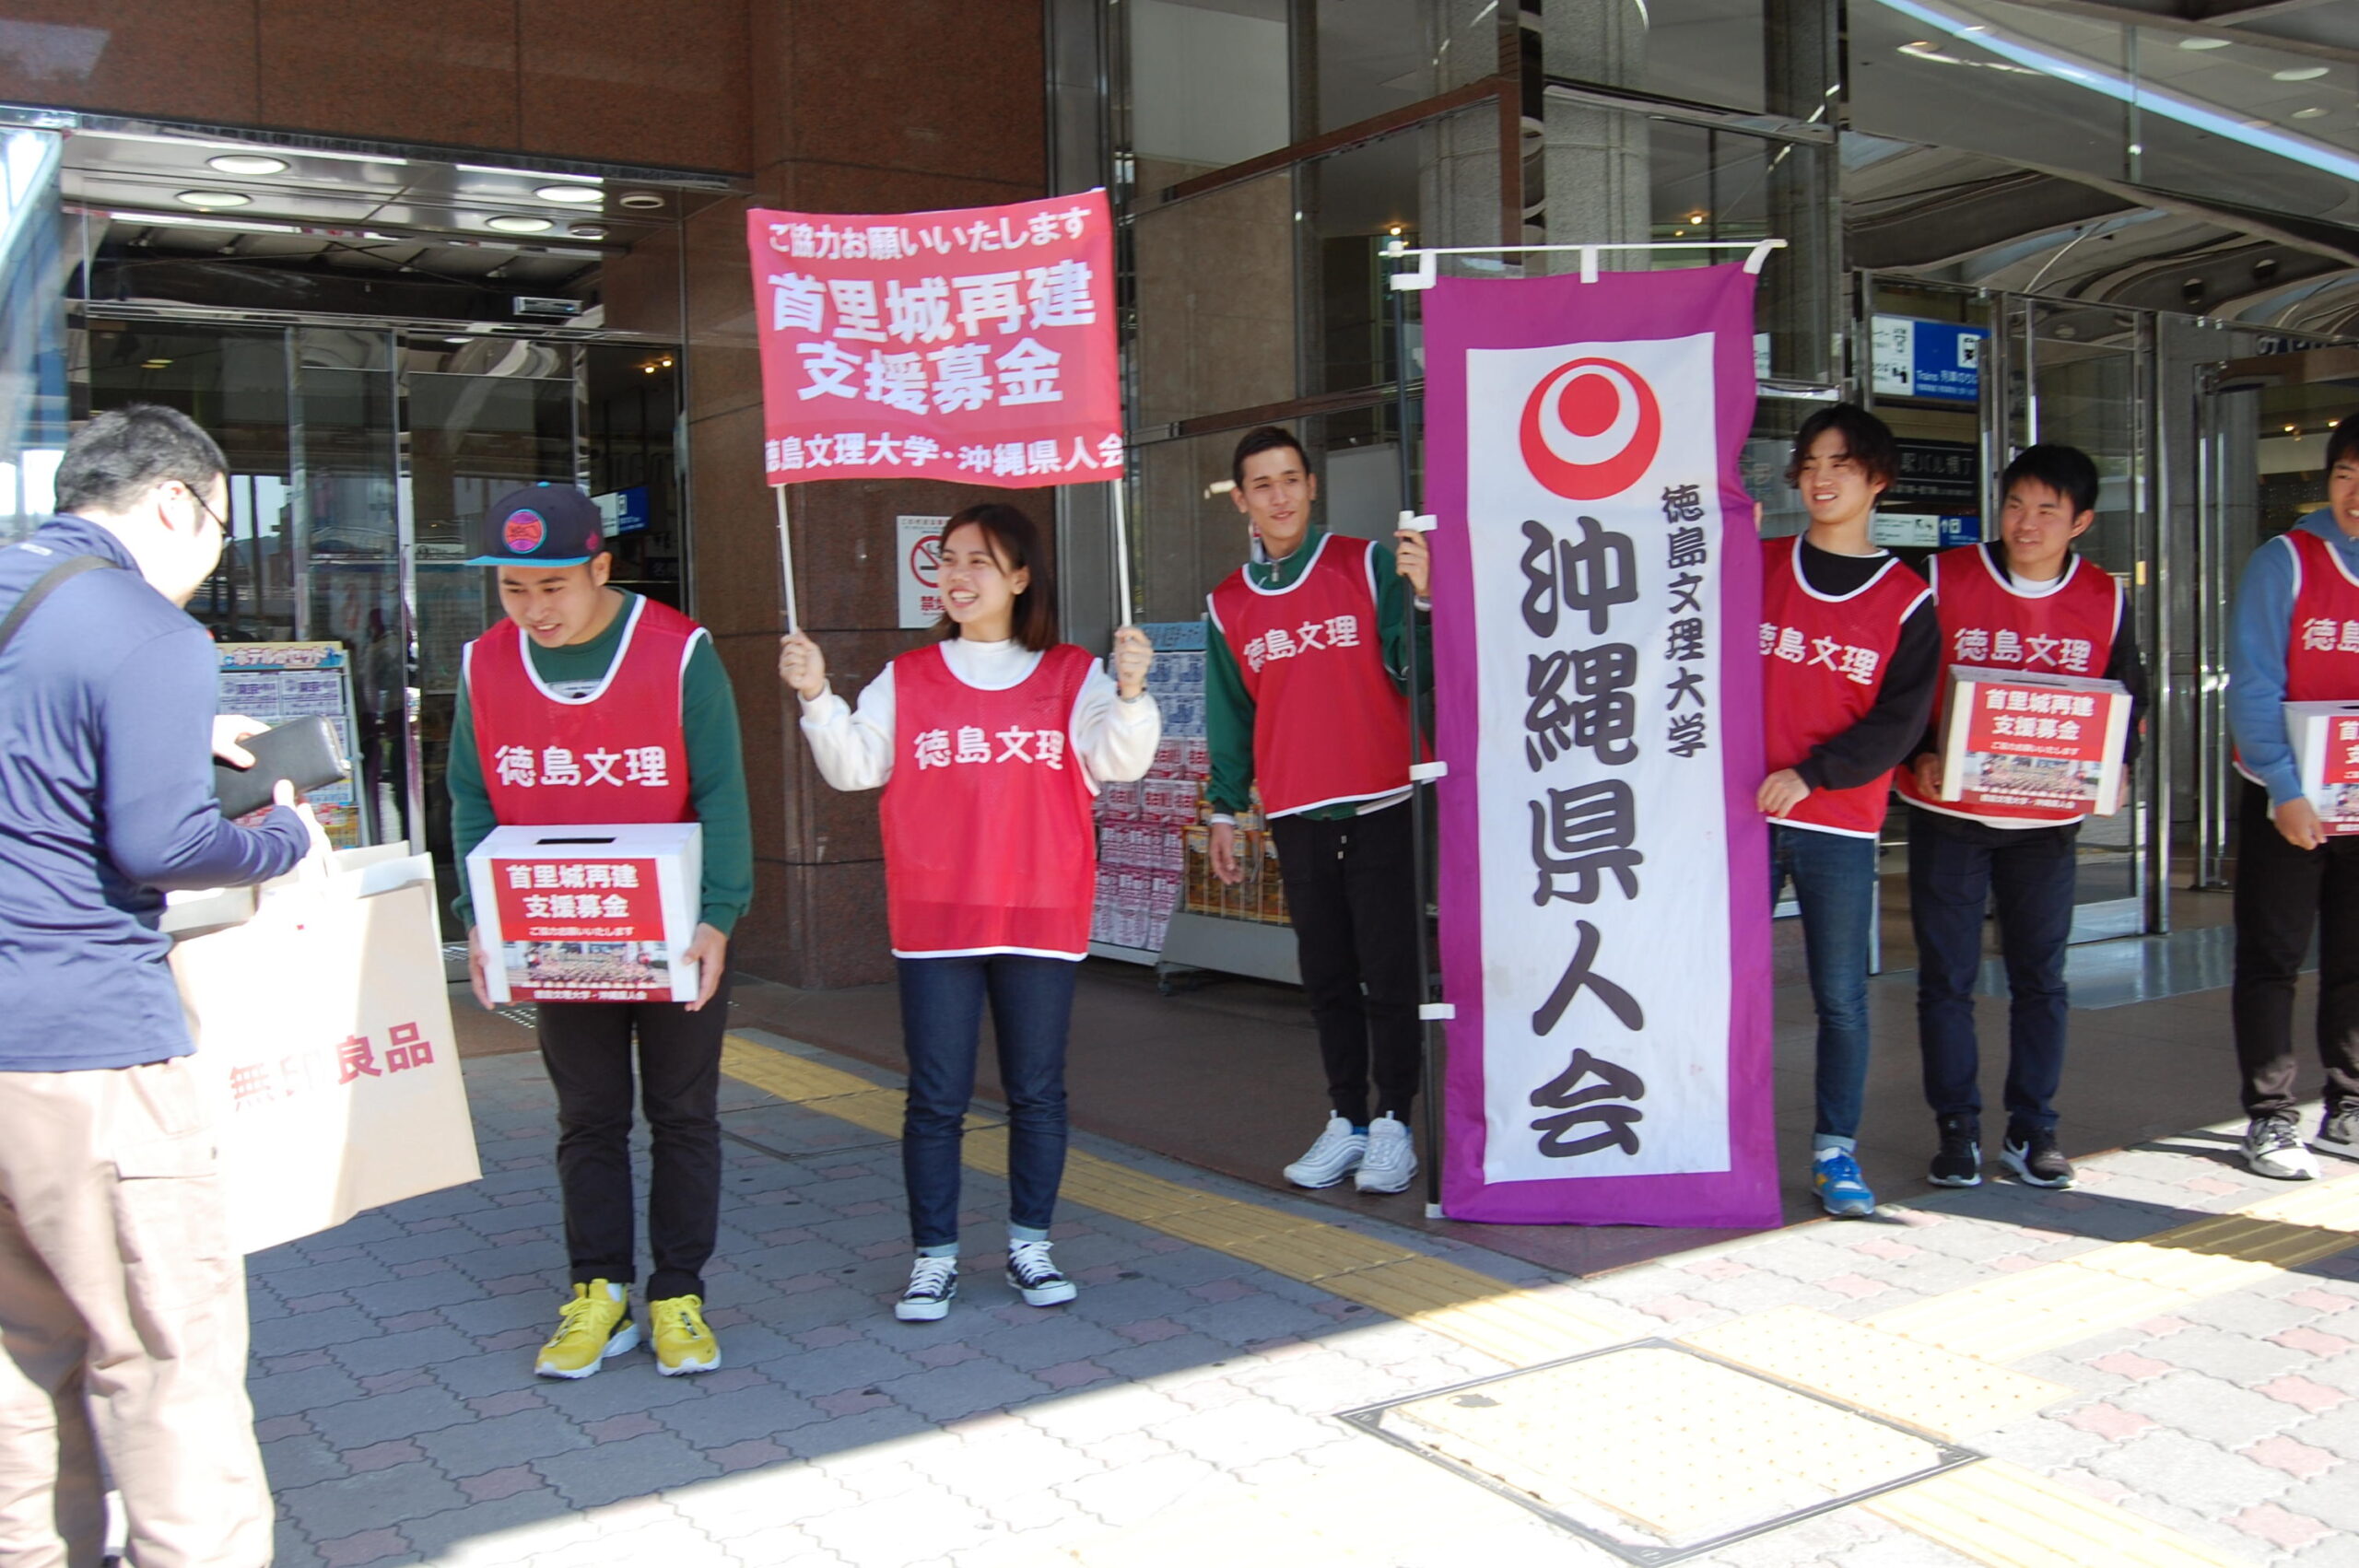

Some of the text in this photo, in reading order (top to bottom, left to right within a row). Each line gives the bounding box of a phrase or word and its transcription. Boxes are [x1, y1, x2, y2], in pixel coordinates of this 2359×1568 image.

[769, 206, 1092, 260] ご協力お願いいたします
[768, 258, 1096, 345] 首里城再建
[796, 337, 1063, 415] 支援募金
[1243, 614, 1361, 674] 徳島文理
[1661, 484, 1707, 758] 徳島文理大学
[1954, 627, 2092, 673] 徳島文理
[1985, 688, 2095, 718] 首里城再建
[914, 725, 1065, 770] 徳島文理
[1991, 715, 2081, 741] 支援募金
[495, 744, 670, 787] 徳島文理
[1521, 515, 1645, 1158] 沖縄県人会
[505, 864, 640, 890] 首里城再建
[522, 894, 630, 919] 支援募金
